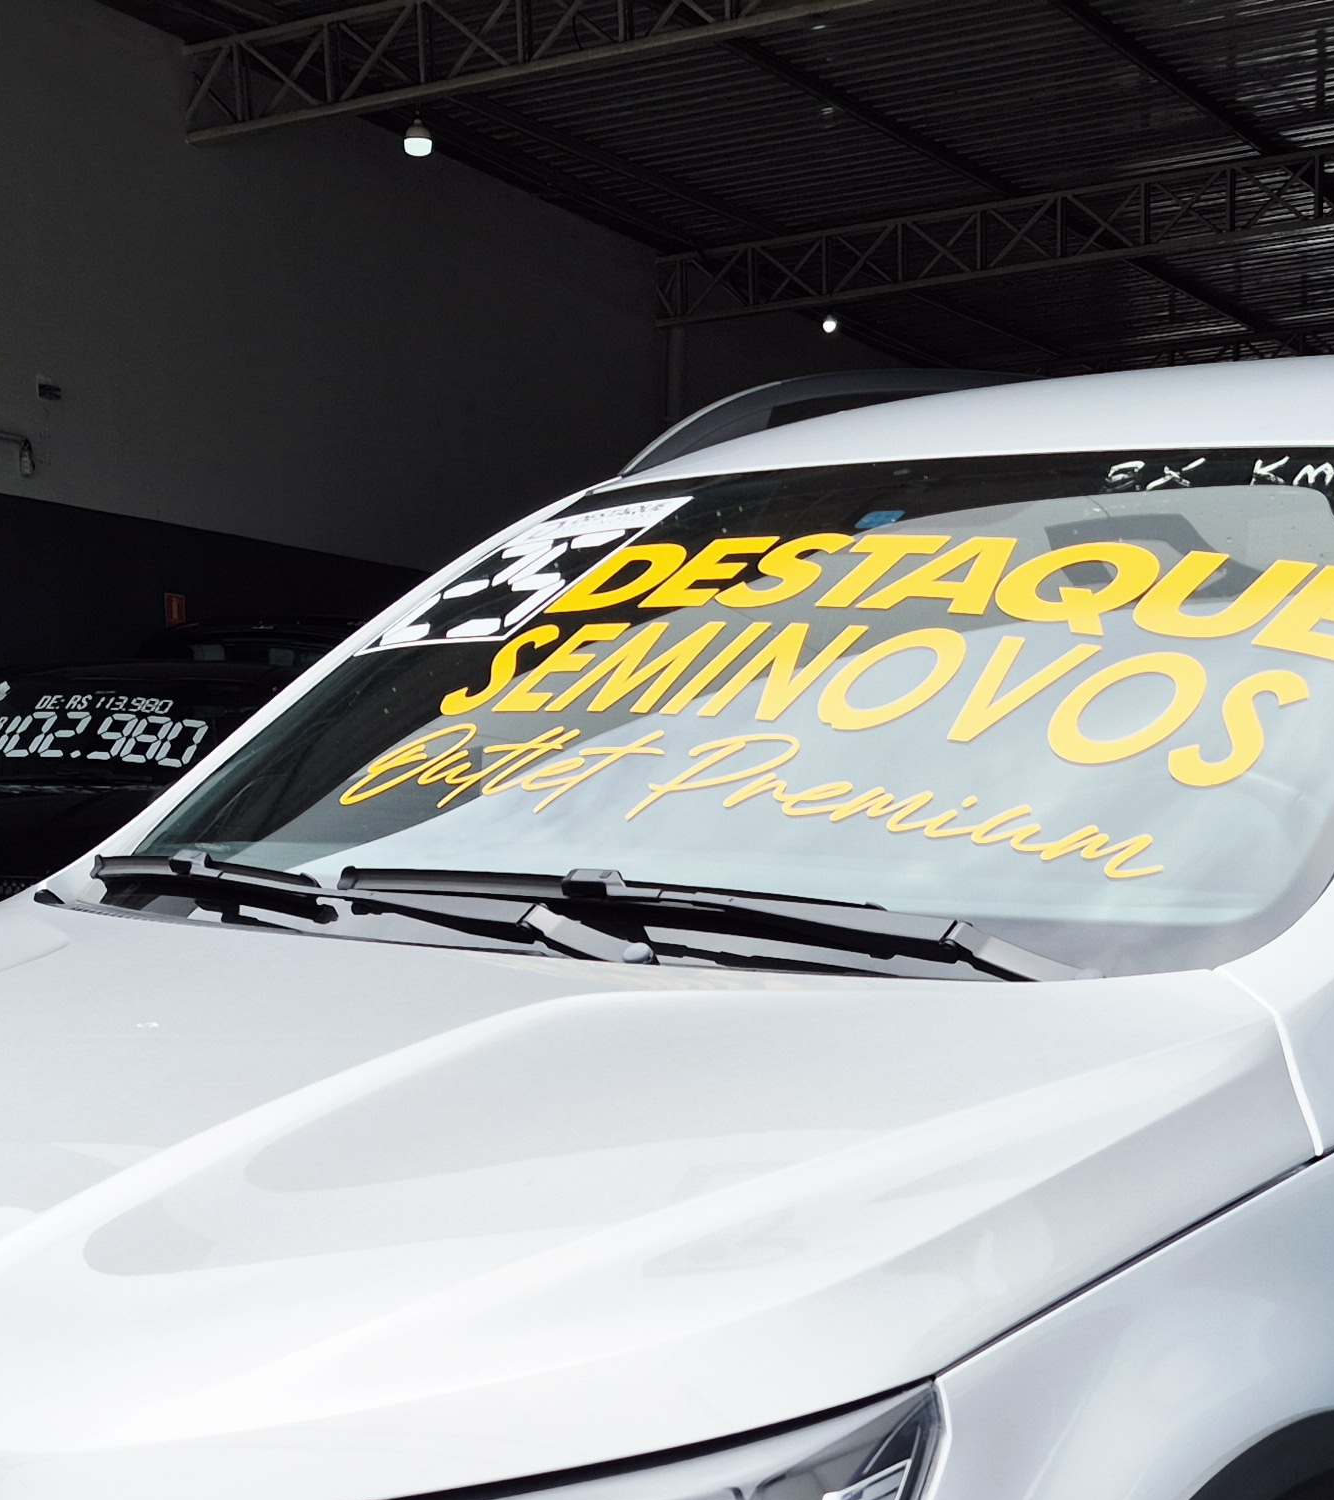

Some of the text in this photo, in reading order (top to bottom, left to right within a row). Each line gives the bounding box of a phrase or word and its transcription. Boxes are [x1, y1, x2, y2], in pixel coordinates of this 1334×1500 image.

[95, 696, 174, 715] 113.980
[439, 621, 1310, 788] SEMINOVOS
[339, 722, 1166, 880] Outlet Premium
